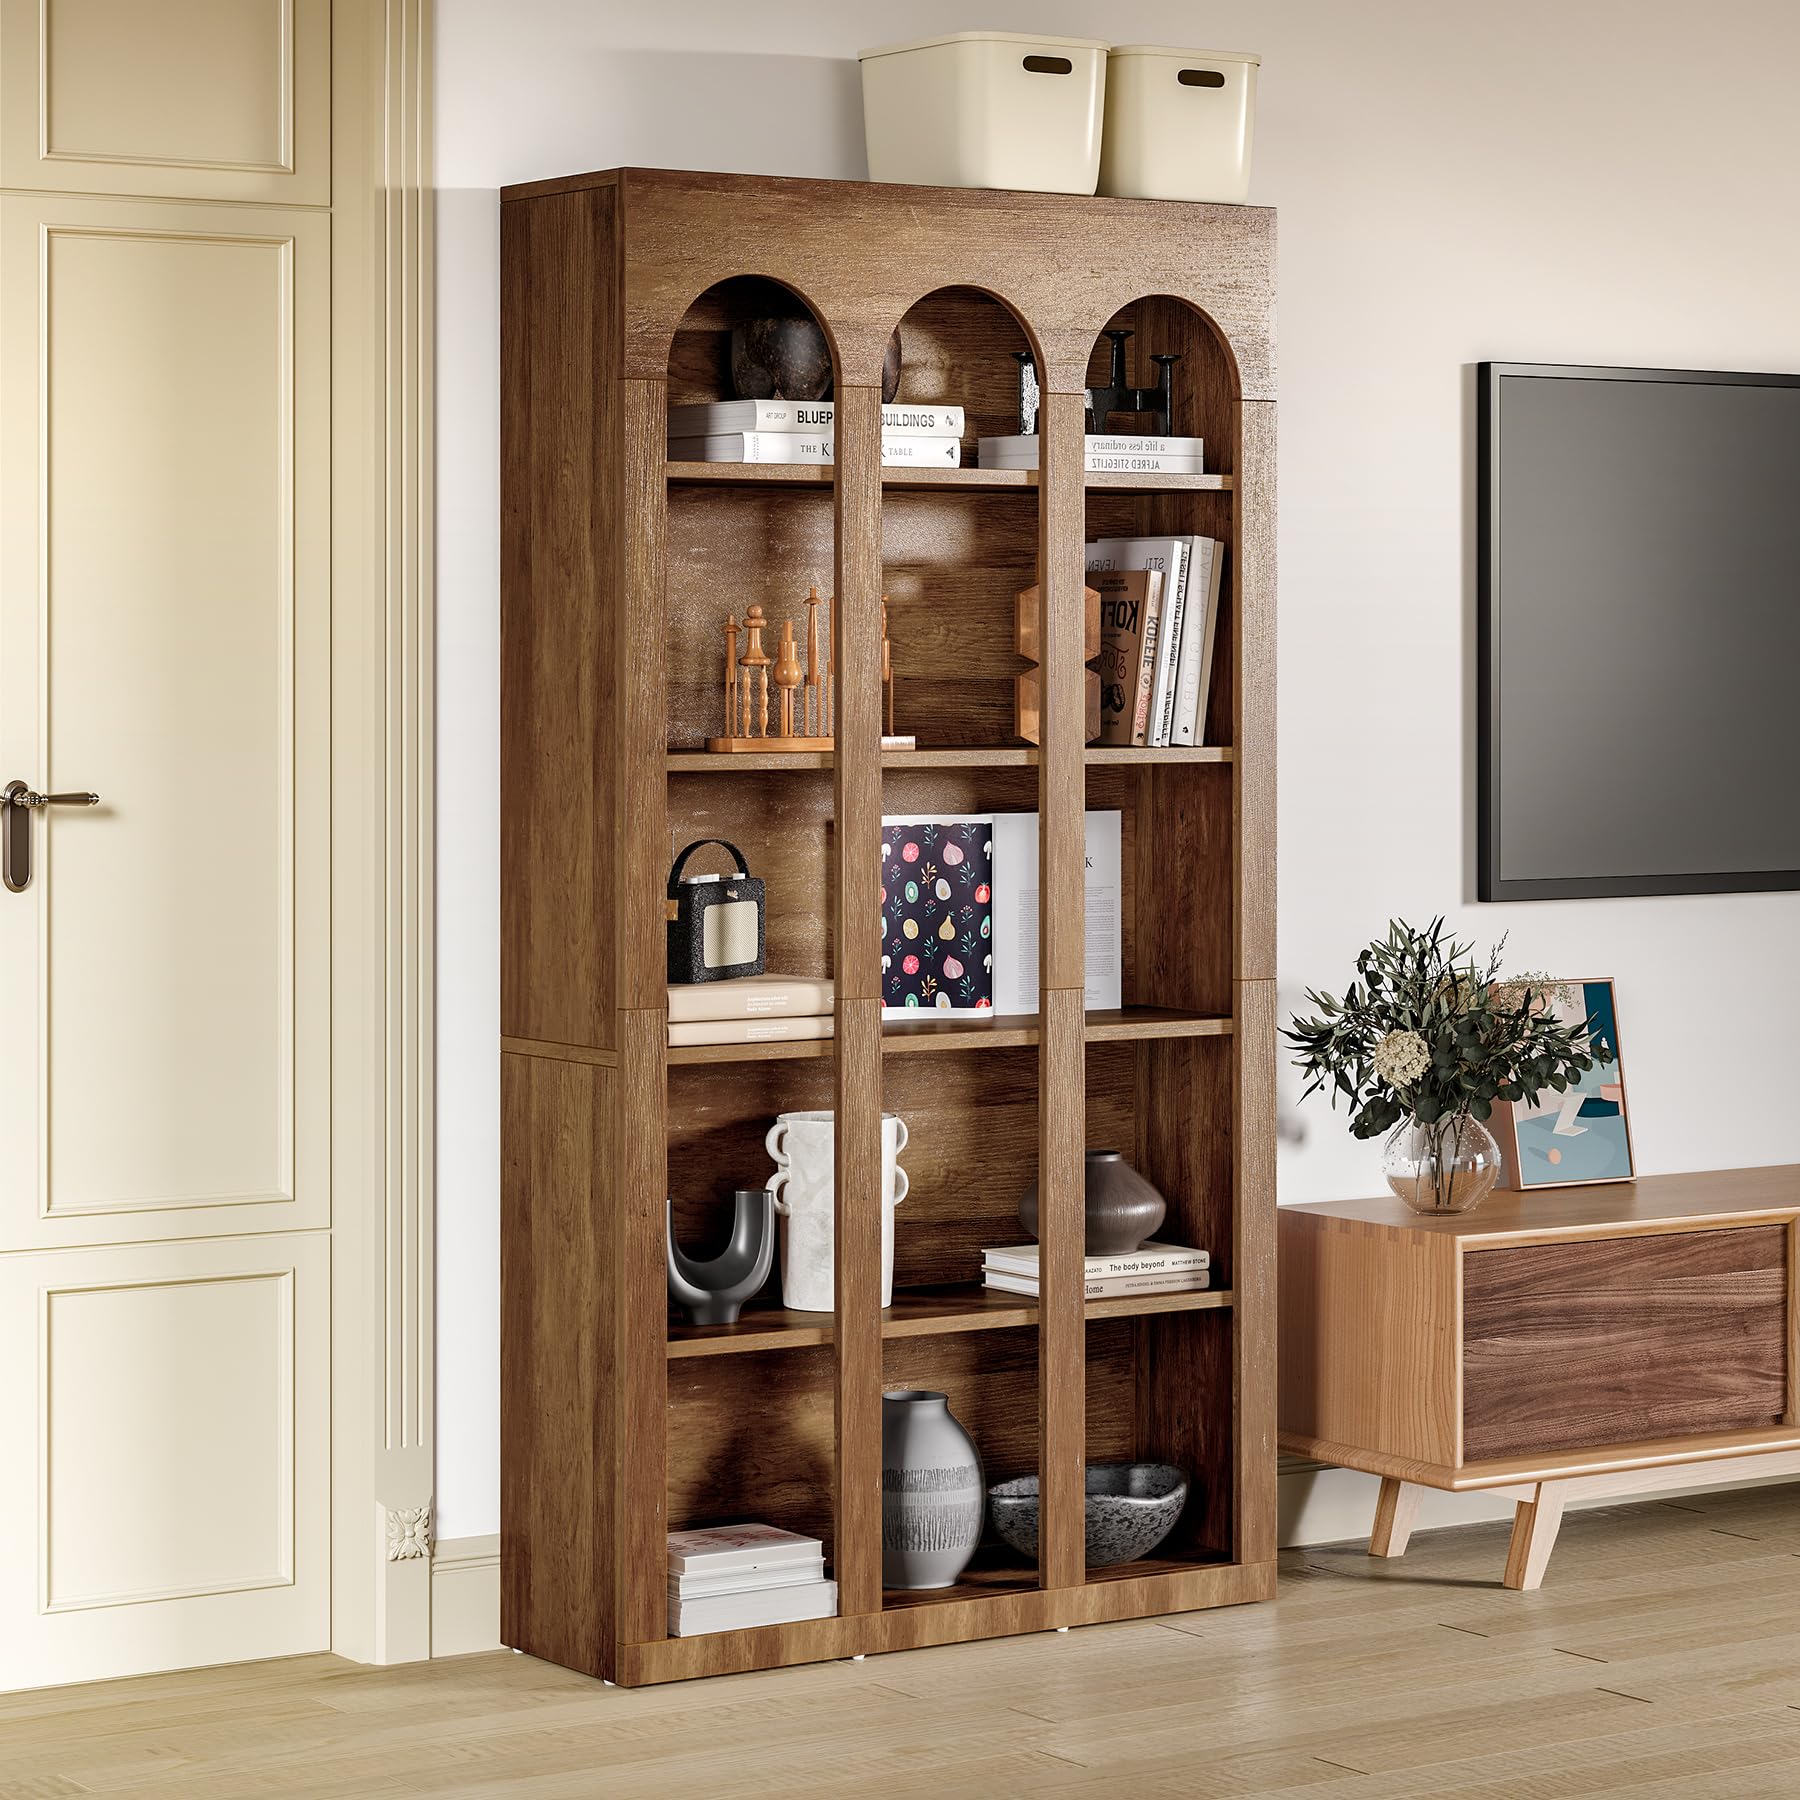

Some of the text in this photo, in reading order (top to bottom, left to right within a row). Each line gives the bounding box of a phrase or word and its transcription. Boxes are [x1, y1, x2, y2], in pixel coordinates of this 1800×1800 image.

[797, 410, 833, 424] BLUEP
[800, 444, 818, 453] THE
[888, 447, 913, 456] TABLE
[1109, 1263, 1122, 1272] The
[1123, 1261, 1139, 1271] body
[1141, 1260, 1165, 1270] beyond
[1192, 1257, 1206, 1265] STONE
